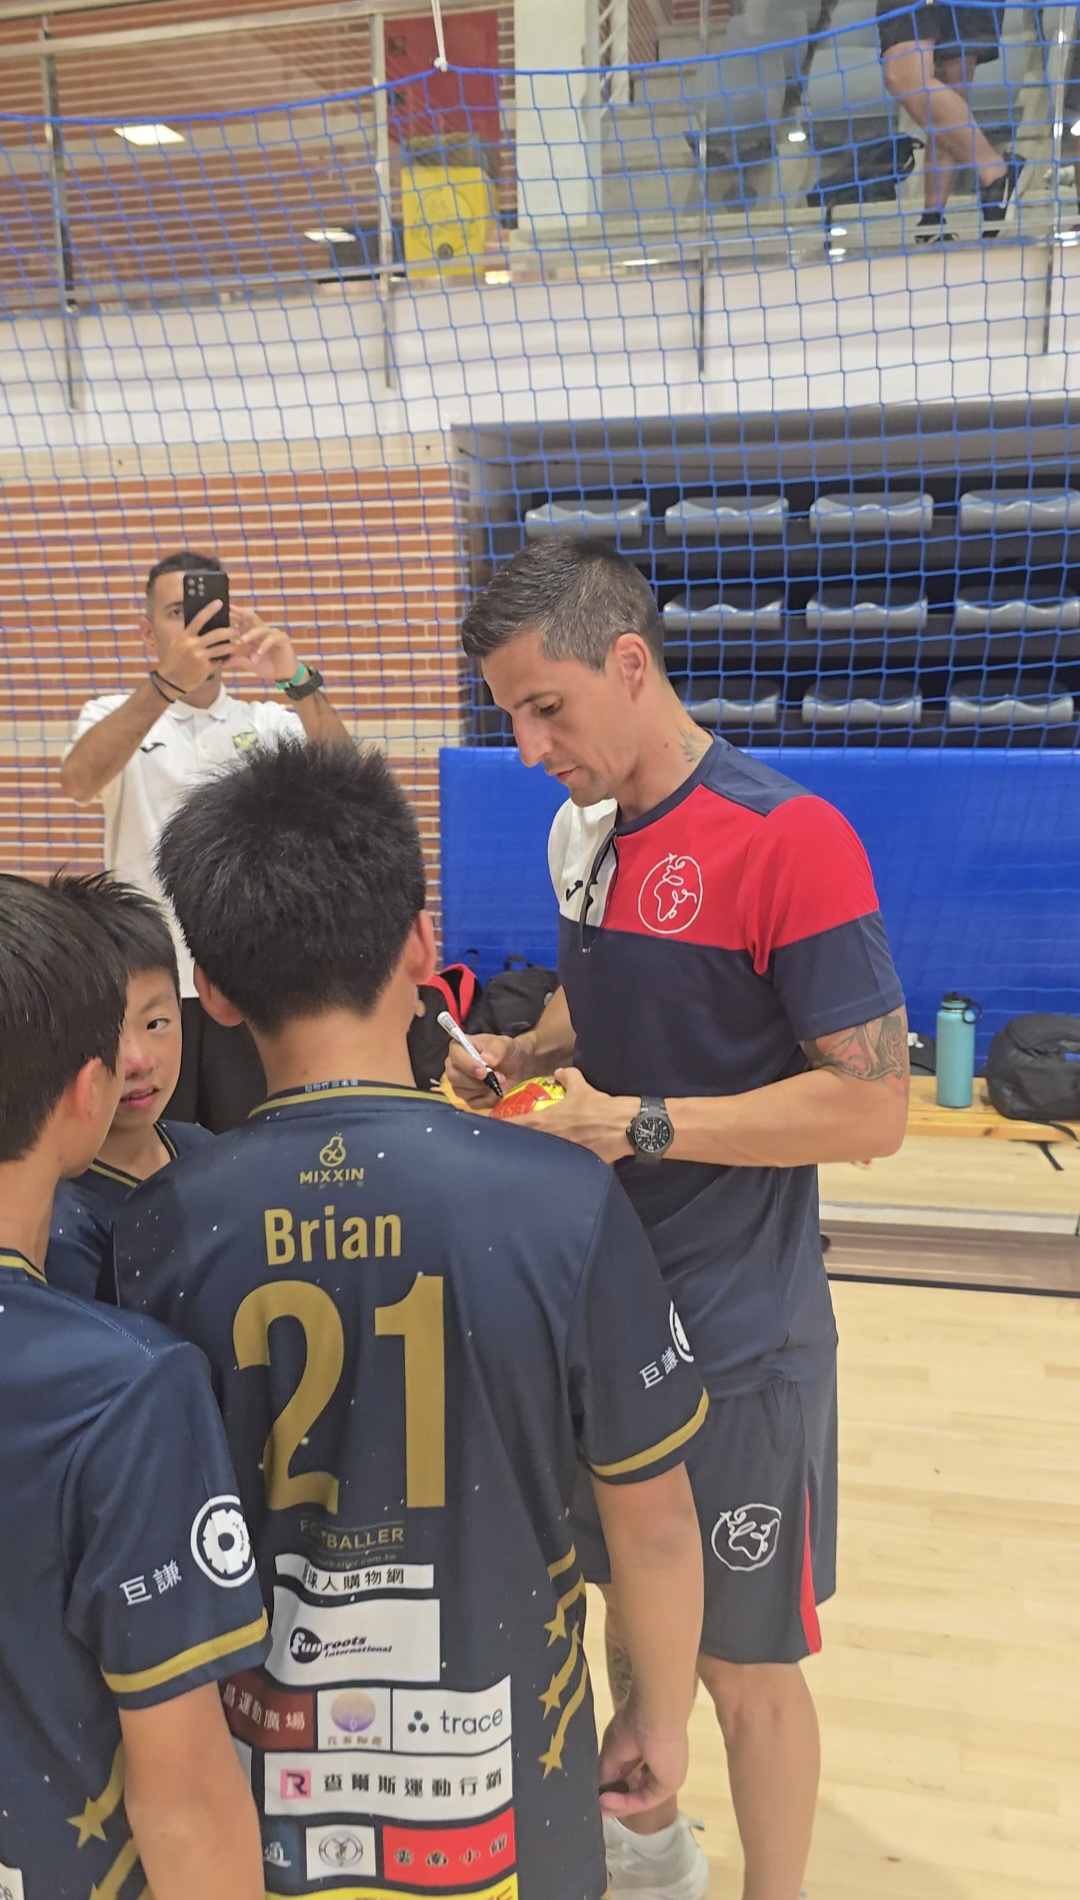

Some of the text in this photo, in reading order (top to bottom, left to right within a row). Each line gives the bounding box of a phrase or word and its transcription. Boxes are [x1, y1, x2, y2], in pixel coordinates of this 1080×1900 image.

[299, 1167, 364, 1185] MIXXIN
[264, 1205, 402, 1266] Brian
[638, 1345, 679, 1390] 巨謙
[232, 1275, 446, 1516] 21
[299, 1519, 405, 1550] FOBALLER
[119, 1559, 182, 1606] 巨謙
[440, 1708, 503, 1735] trace
[323, 1767, 503, 1798] 查爾斯運動行銷
